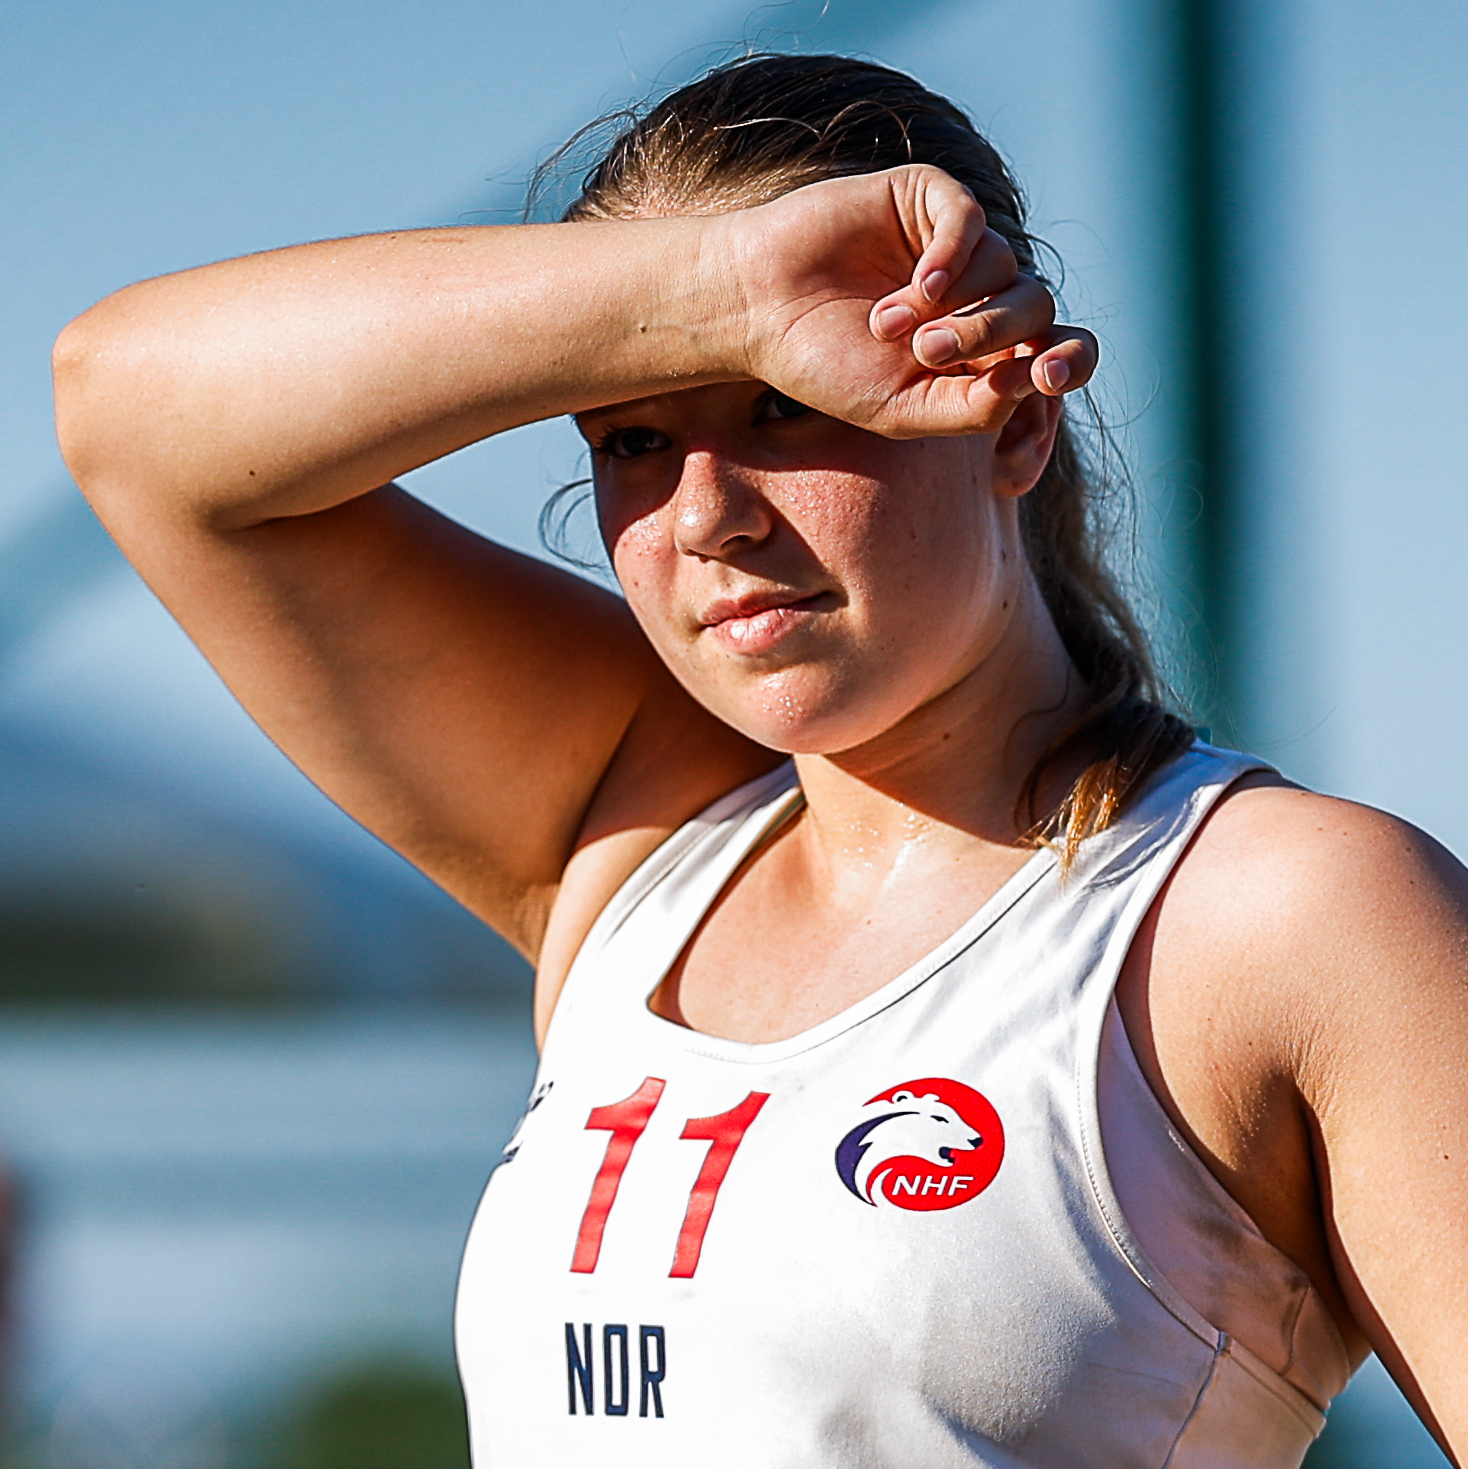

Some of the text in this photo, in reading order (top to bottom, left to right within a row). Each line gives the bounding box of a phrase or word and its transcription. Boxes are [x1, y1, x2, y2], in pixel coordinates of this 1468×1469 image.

[569, 1076, 771, 1279] 11
[891, 1175, 974, 1196] NHF
[565, 1322, 666, 1419] NOR
